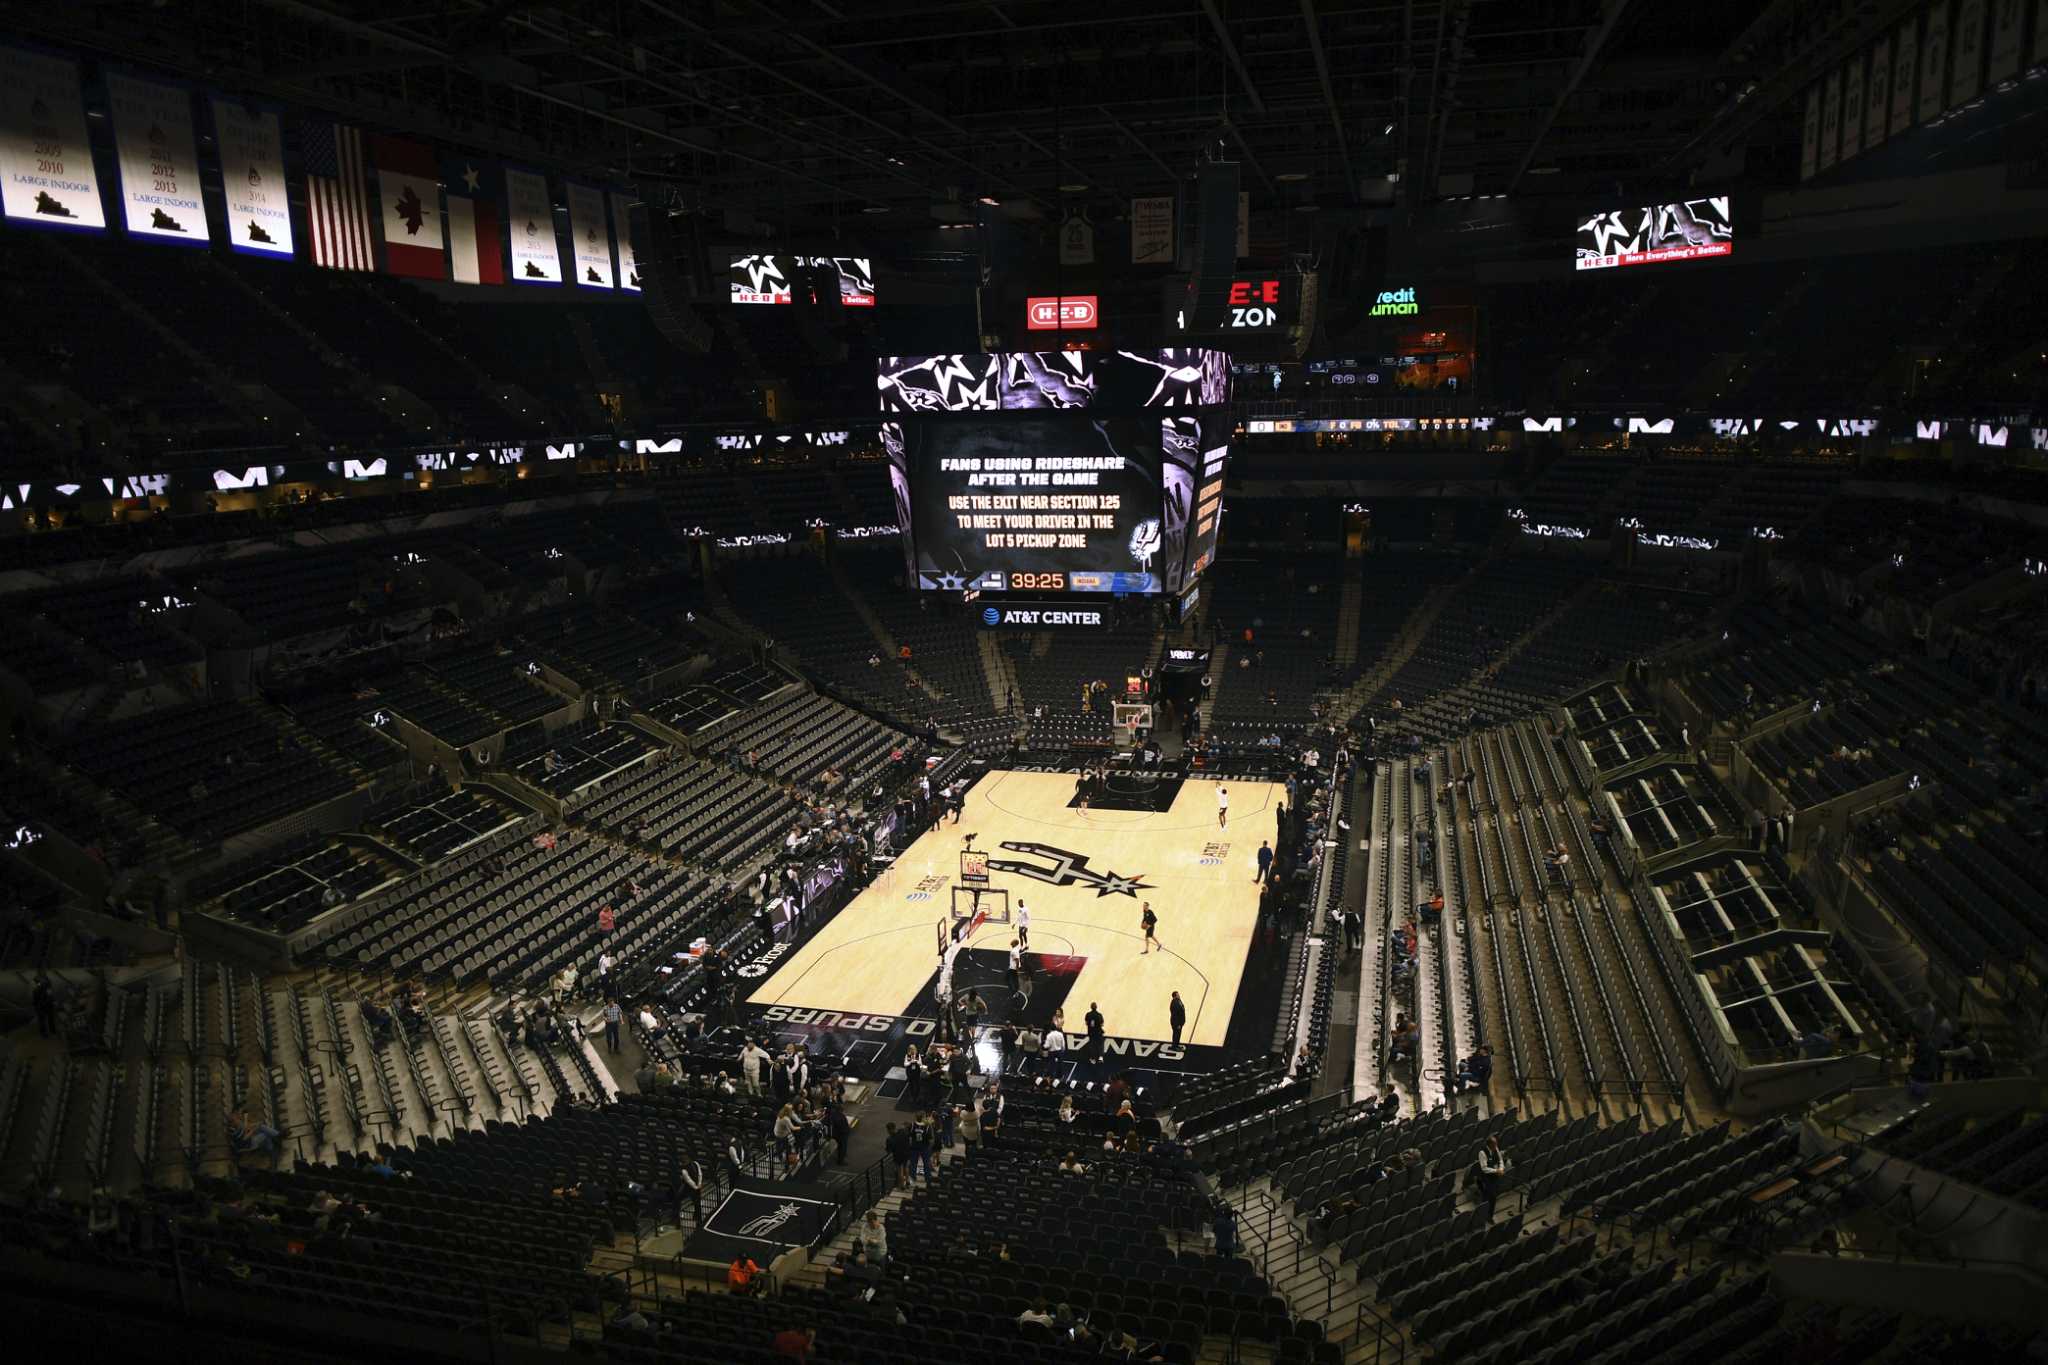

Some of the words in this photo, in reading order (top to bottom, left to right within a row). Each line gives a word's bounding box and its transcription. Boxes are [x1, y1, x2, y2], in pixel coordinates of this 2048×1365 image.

[37, 159, 64, 175] 2010
[152, 163, 176, 178] 2012
[14, 173, 50, 187] LARGE
[51, 179, 91, 193] INDOOR
[154, 179, 177, 194] 2013
[133, 193, 162, 205] LARGE
[163, 197, 200, 210] INDOOR
[1039, 306, 1088, 319] H-E-B
[1369, 303, 1418, 316] uman
[941, 458, 981, 471] FANS
[984, 457, 1032, 470] USING
[1036, 457, 1125, 470] RIDESHARE
[968, 473, 1016, 486] AFTER
[1020, 473, 1049, 485] THE
[1052, 473, 1099, 485] GAME
[949, 495, 969, 509] USE
[970, 495, 992, 509] THE
[993, 495, 1018, 509] EXIT
[1020, 495, 1048, 509] NEAR
[1050, 495, 1098, 509] SECTION
[1100, 495, 1120, 509] 125
[957, 515, 970, 528] TO
[974, 515, 1001, 528] MEET
[1004, 515, 1034, 528] YOUR
[1035, 515, 1075, 528] DRIVER
[1078, 515, 1091, 528] IN
[1093, 515, 1114, 528] THE
[985, 534, 1004, 548] LOT
[1006, 534, 1014, 548] 5
[1016, 534, 1057, 548] PICKUP
[1058, 534, 1086, 548] ZONE
[1011, 573, 1064, 589] 39:25
[1004, 610, 1040, 624] AT&T
[1042, 611, 1101, 625] CENTER
[1011, 765, 1062, 774] SAN
[1188, 773, 1272, 783] SPURS
[752, 942, 792, 965] Frost
[762, 1006, 894, 1032] SPURS
[1103, 1038, 1187, 1061] SAN
